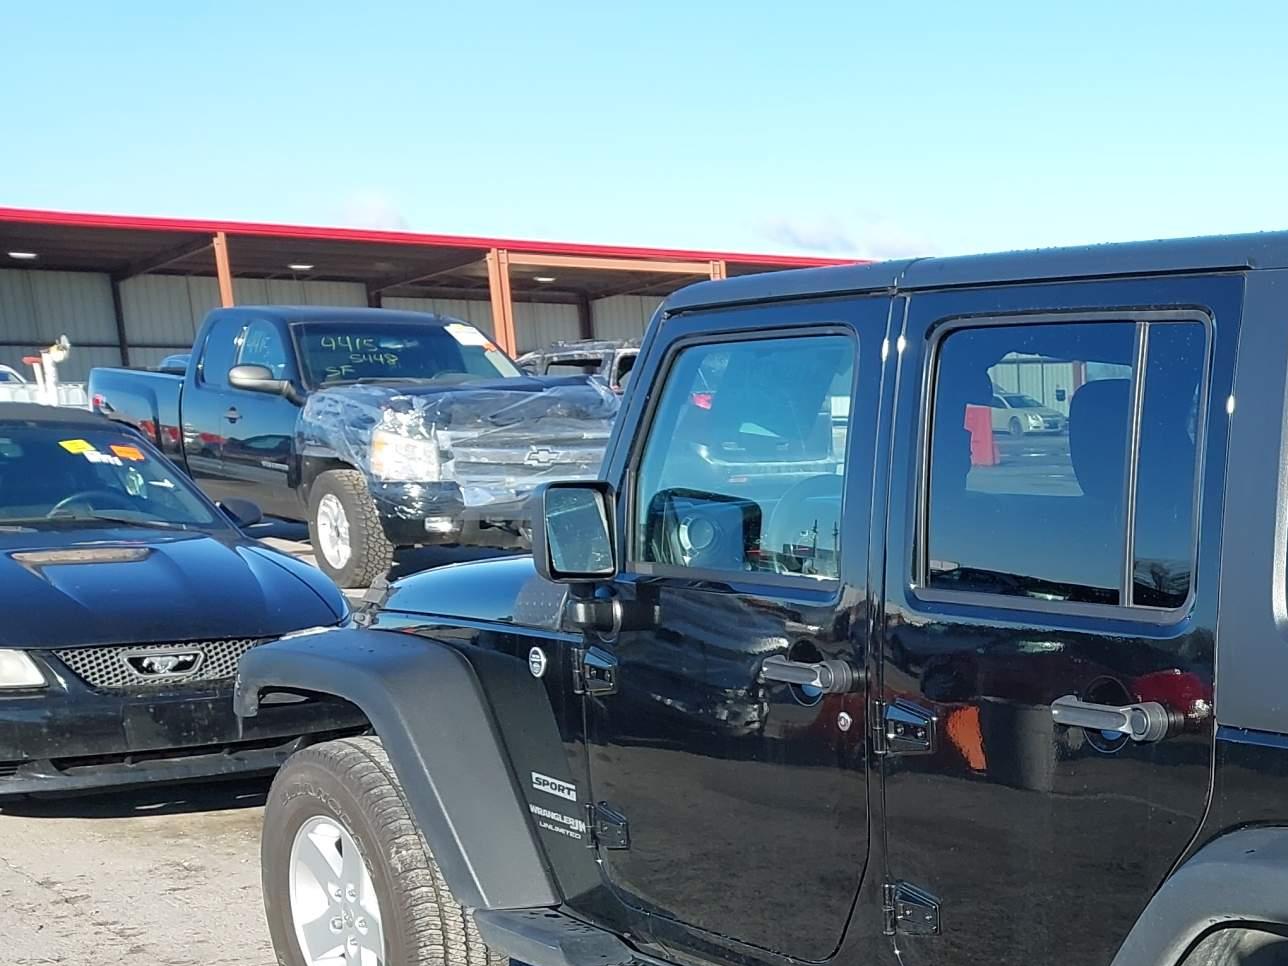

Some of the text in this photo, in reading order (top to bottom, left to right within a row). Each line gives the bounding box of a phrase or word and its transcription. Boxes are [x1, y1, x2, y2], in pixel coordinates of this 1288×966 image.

[321, 335, 378, 352] 4415
[532, 776, 576, 796] SPORT
[539, 820, 582, 840] UNLIMITED
